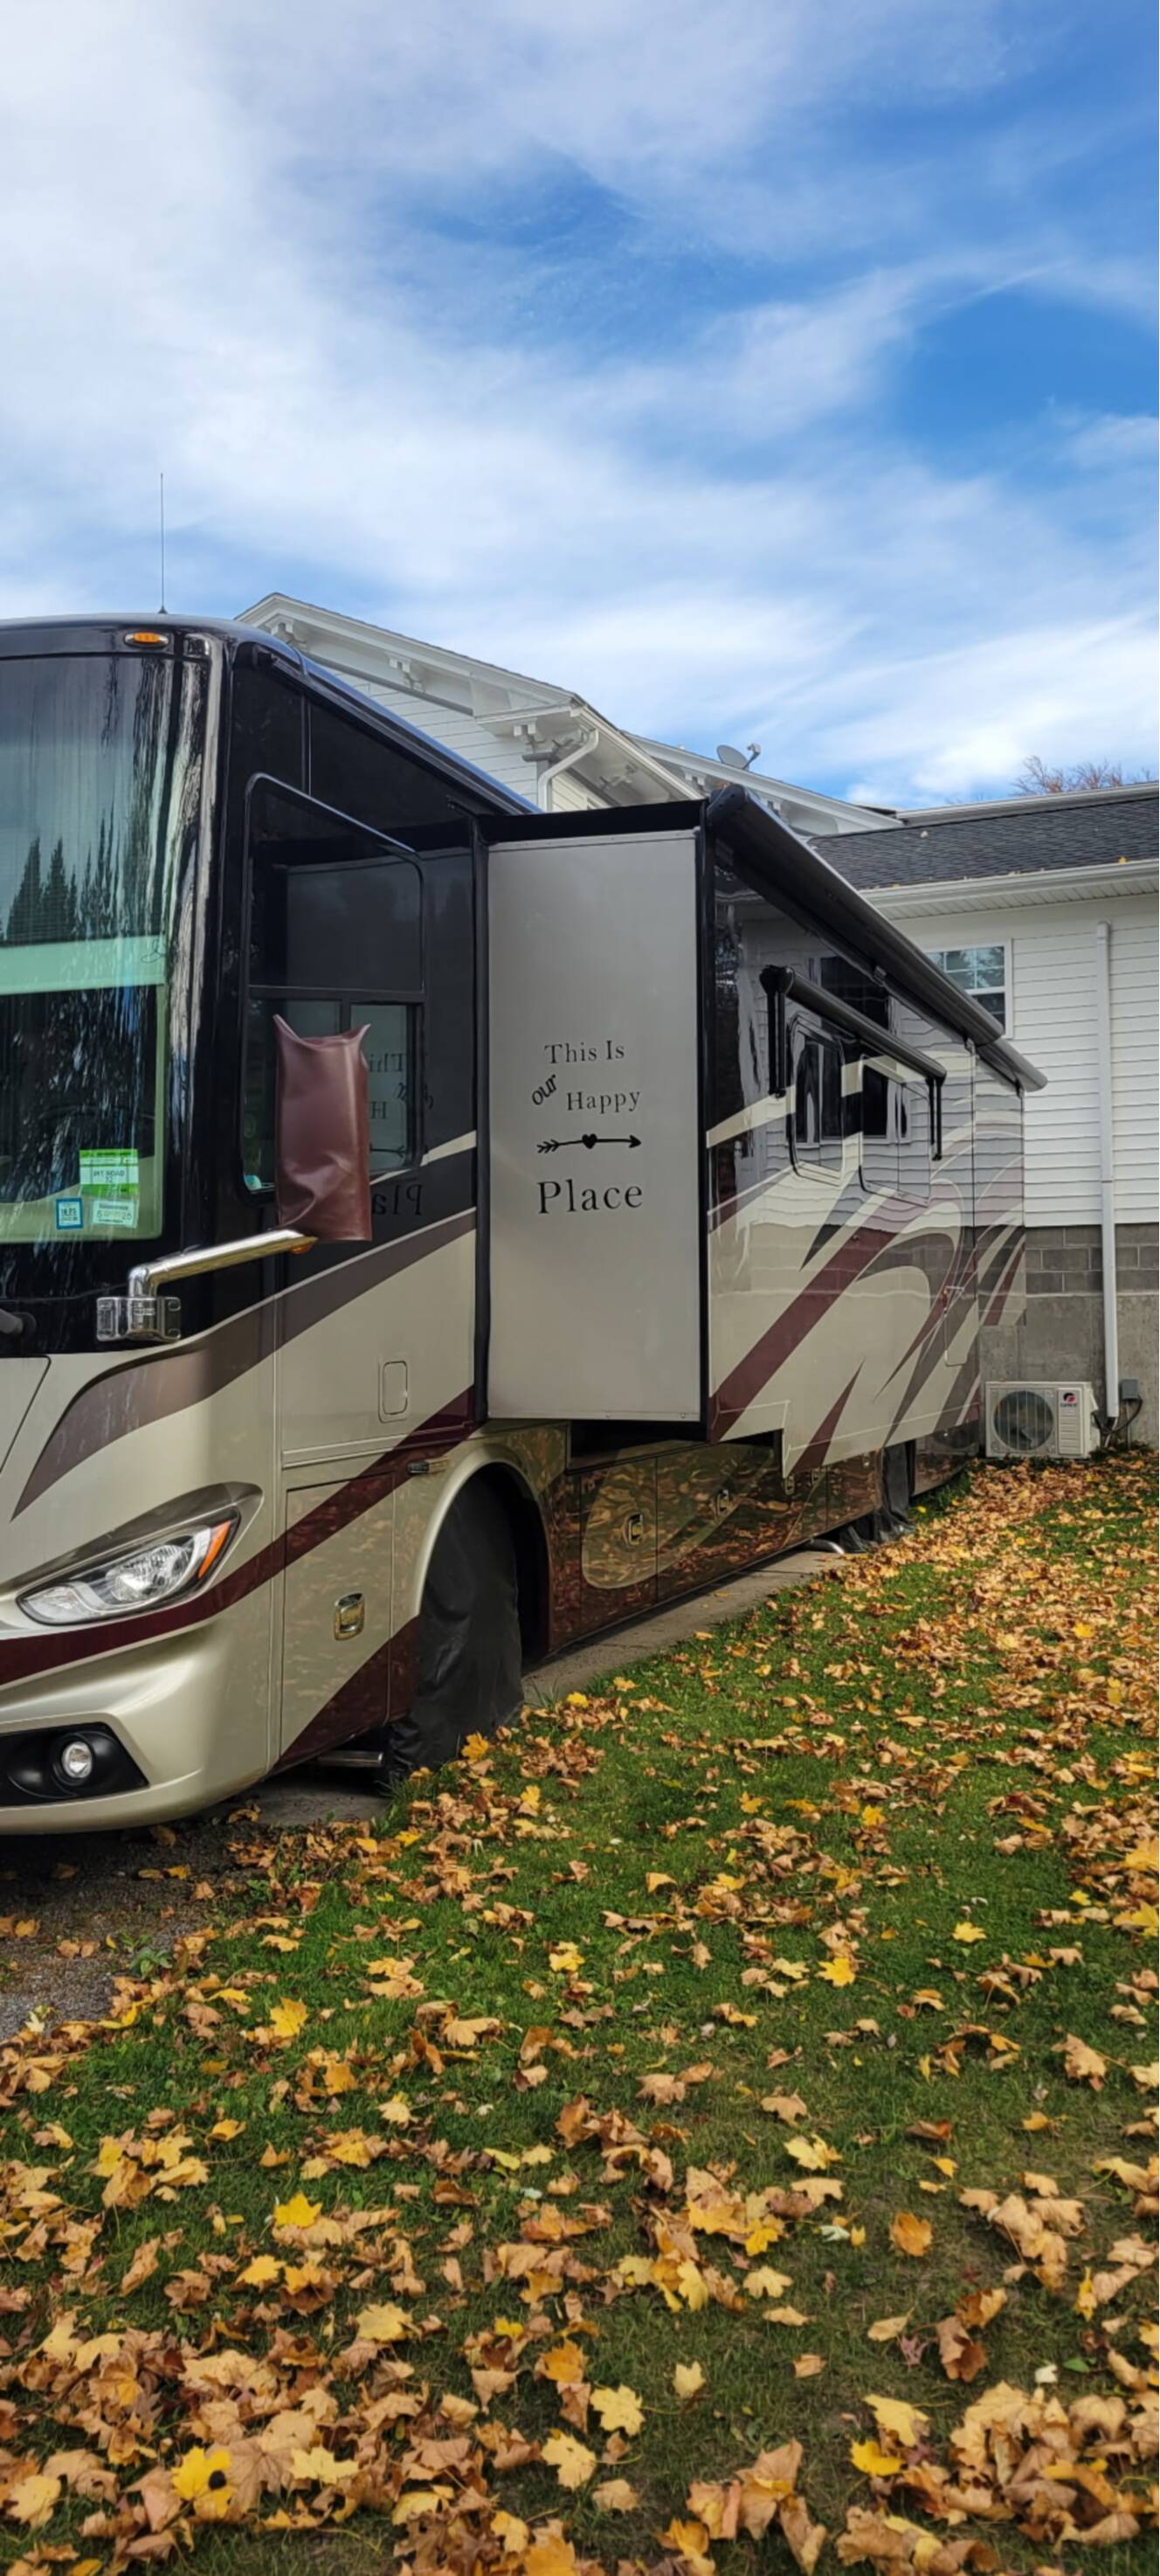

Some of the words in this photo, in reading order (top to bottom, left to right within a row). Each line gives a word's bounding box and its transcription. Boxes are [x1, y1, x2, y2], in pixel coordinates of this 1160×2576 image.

[543, 1042, 597, 1064] This
[605, 1040, 625, 1061] Is
[531, 1074, 557, 1106] our
[566, 1091, 641, 1114] Happy
[536, 1178, 643, 1215] Place
